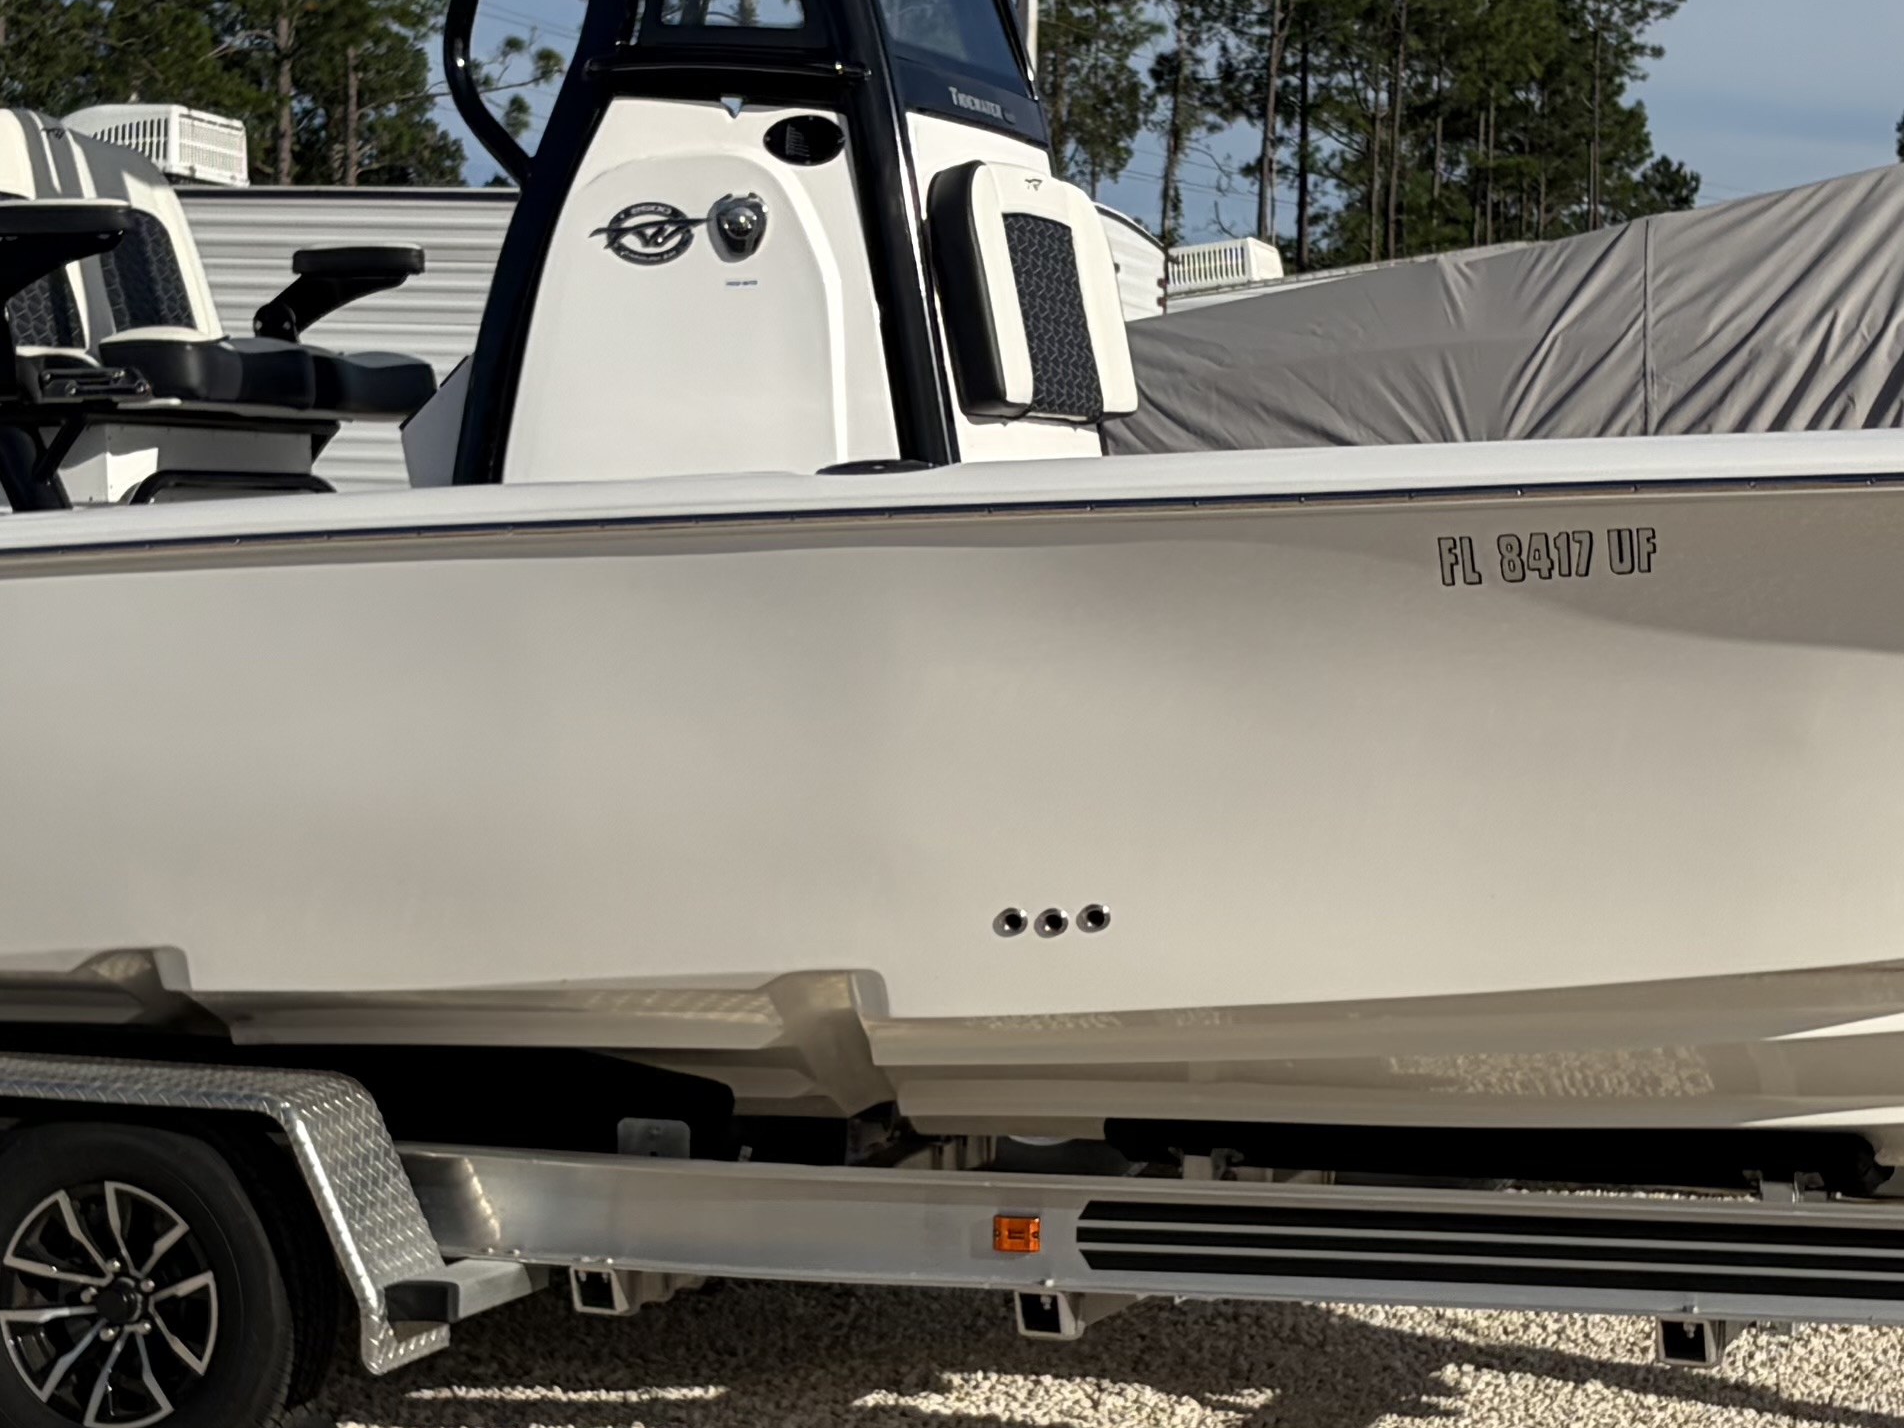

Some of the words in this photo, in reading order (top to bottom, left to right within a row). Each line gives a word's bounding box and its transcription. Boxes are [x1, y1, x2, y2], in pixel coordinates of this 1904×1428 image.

[1437, 536, 1483, 586] FL
[1497, 530, 1594, 583] 8417
[1607, 527, 1657, 575] UF
